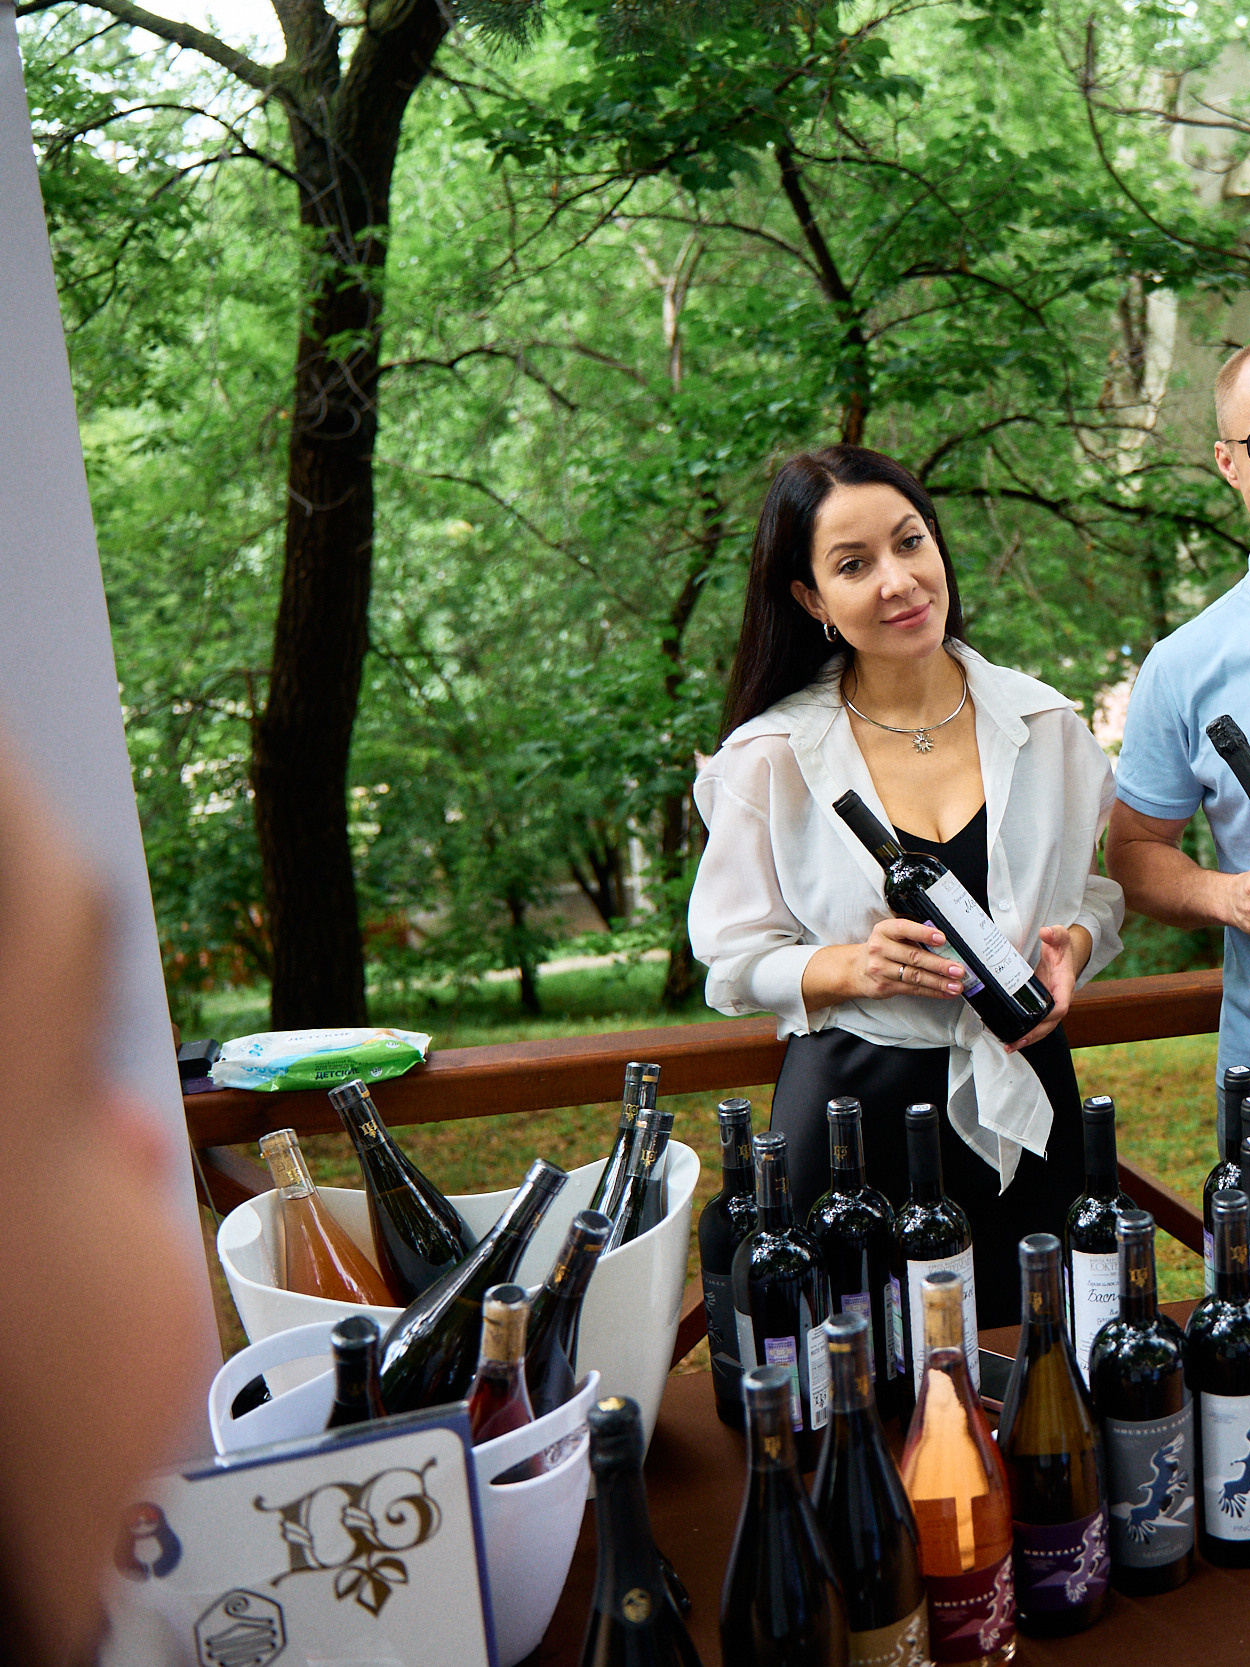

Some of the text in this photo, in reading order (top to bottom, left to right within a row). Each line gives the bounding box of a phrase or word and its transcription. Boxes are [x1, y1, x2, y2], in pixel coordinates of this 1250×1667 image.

[315, 1067, 360, 1081] ДЕТСКИЕ
[1113, 1426, 1168, 1435] MOUNTAIN
[1023, 1545, 1083, 1557] MOUNTAIN
[933, 1591, 996, 1608] MOUNTAIN
